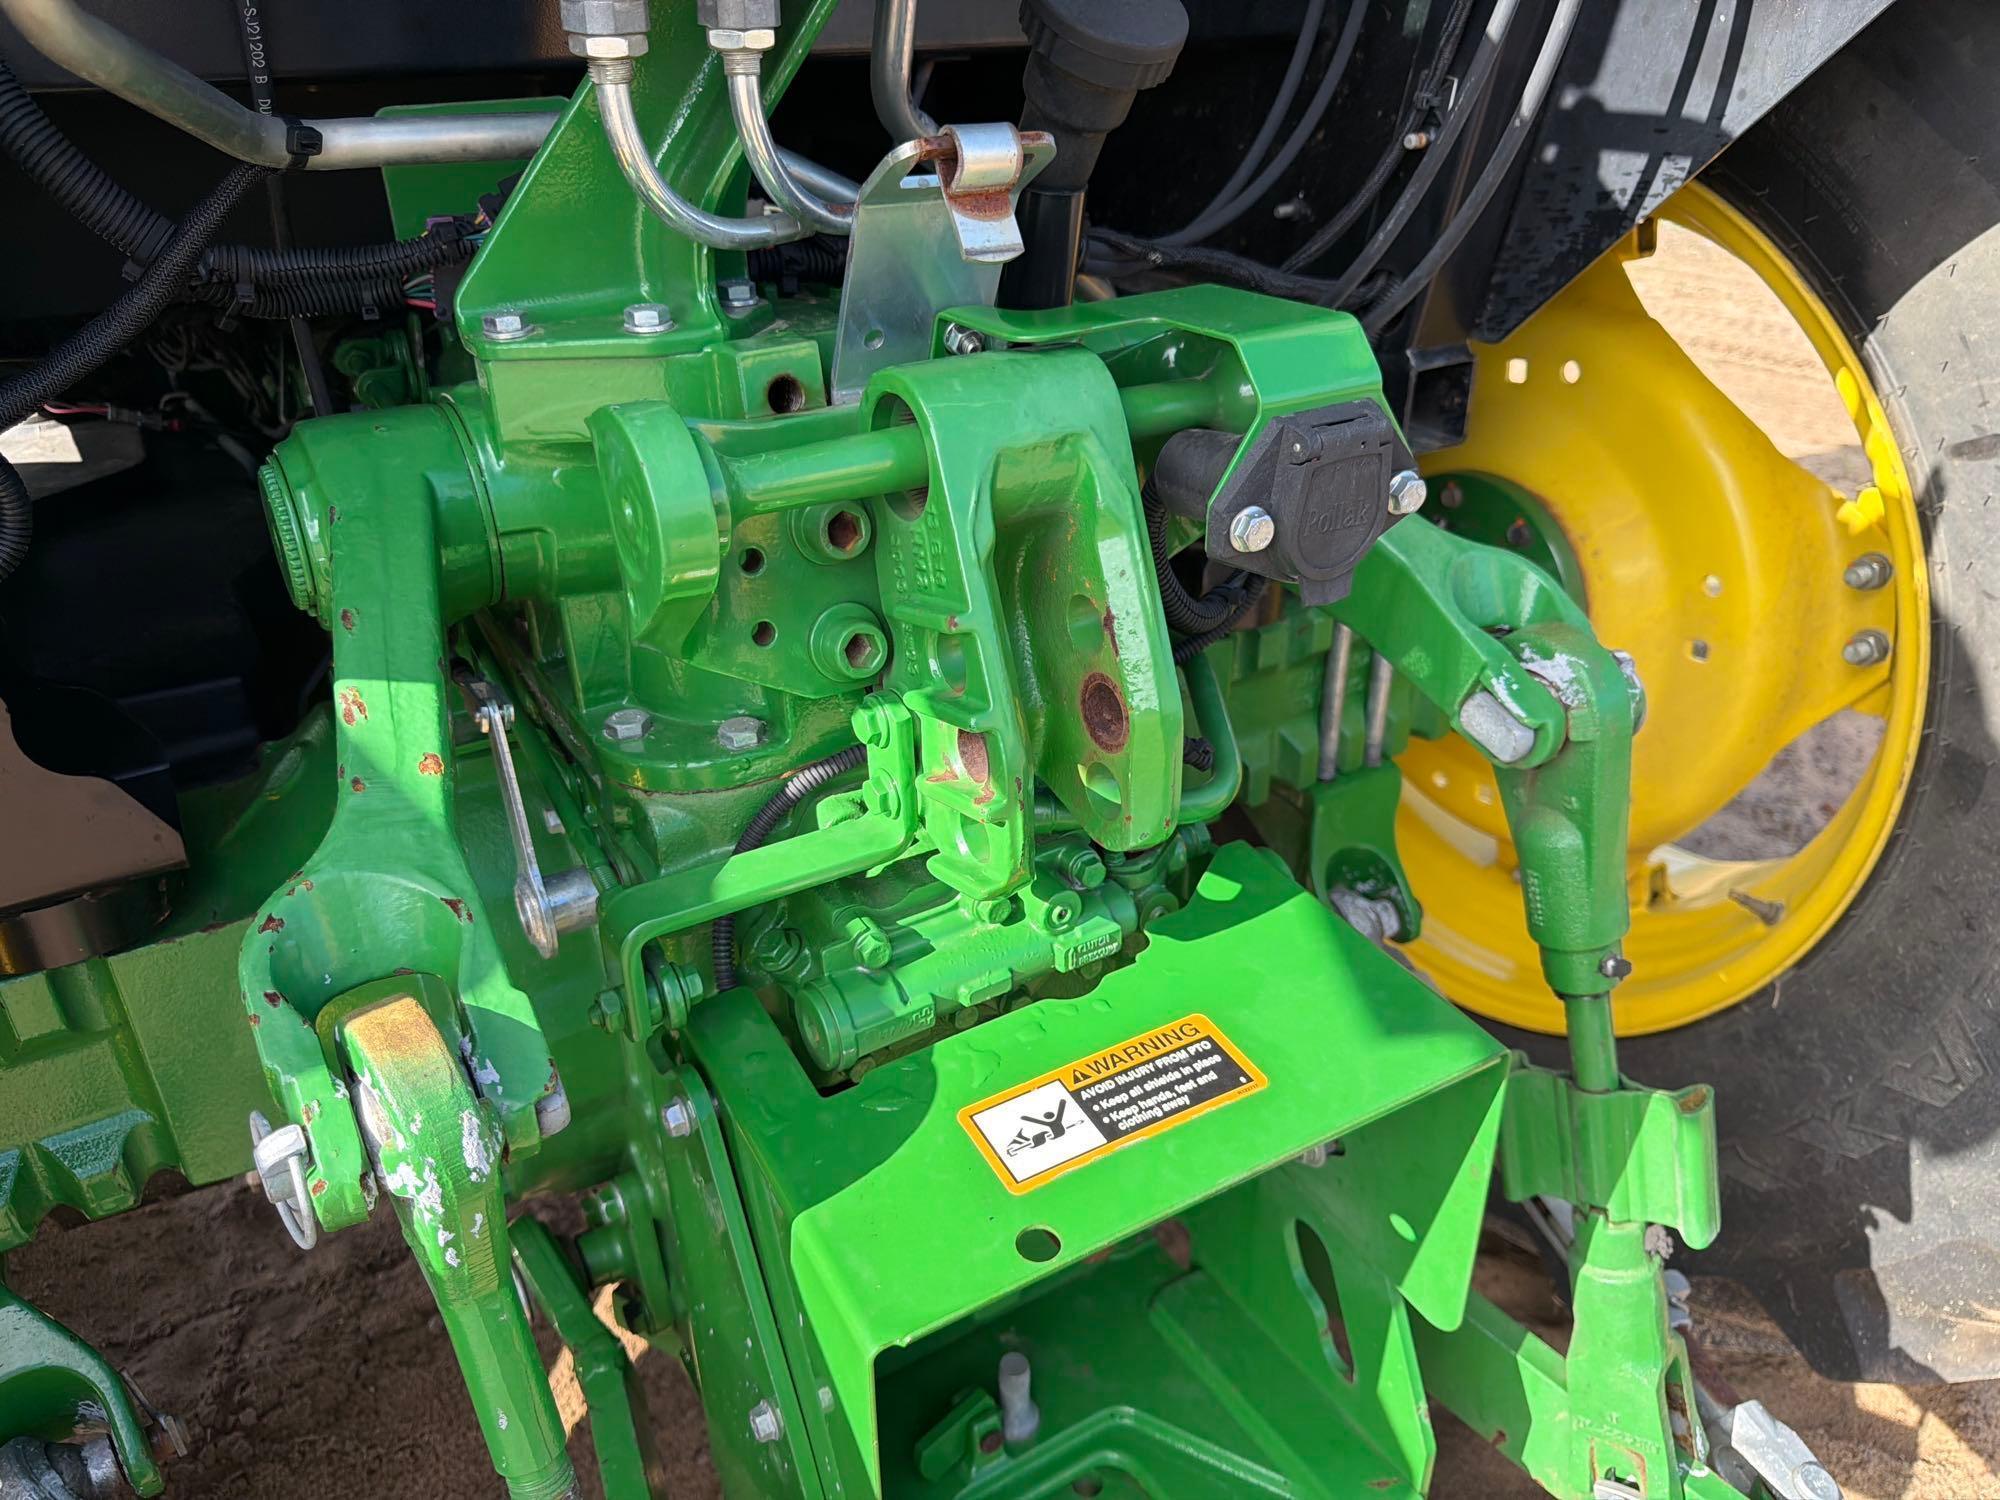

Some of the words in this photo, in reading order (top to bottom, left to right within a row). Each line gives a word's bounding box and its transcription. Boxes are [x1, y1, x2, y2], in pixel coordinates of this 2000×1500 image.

[254, 75, 268, 84] B
[258, 99, 273, 116] DU
[1303, 500, 1369, 536] Pollak
[1085, 1023, 1200, 1074] WARNING
[1081, 1080, 1115, 1100] AVOID
[1115, 1063, 1154, 1085] INJURY
[1155, 1050, 1189, 1068] FROM
[1187, 1041, 1211, 1055] PTO
[1100, 1093, 1129, 1109] Keep
[1129, 1085, 1144, 1097] all
[1144, 1071, 1182, 1091] shields
[1180, 1066, 1194, 1075] in
[1192, 1055, 1222, 1072] place
[1110, 1105, 1139, 1121] Keep
[1138, 1091, 1176, 1109] hands,
[1174, 1080, 1197, 1094] feet
[1196, 1070, 1218, 1085] and
[1118, 1107, 1163, 1130] clothing
[1162, 1095, 1190, 1111] away
